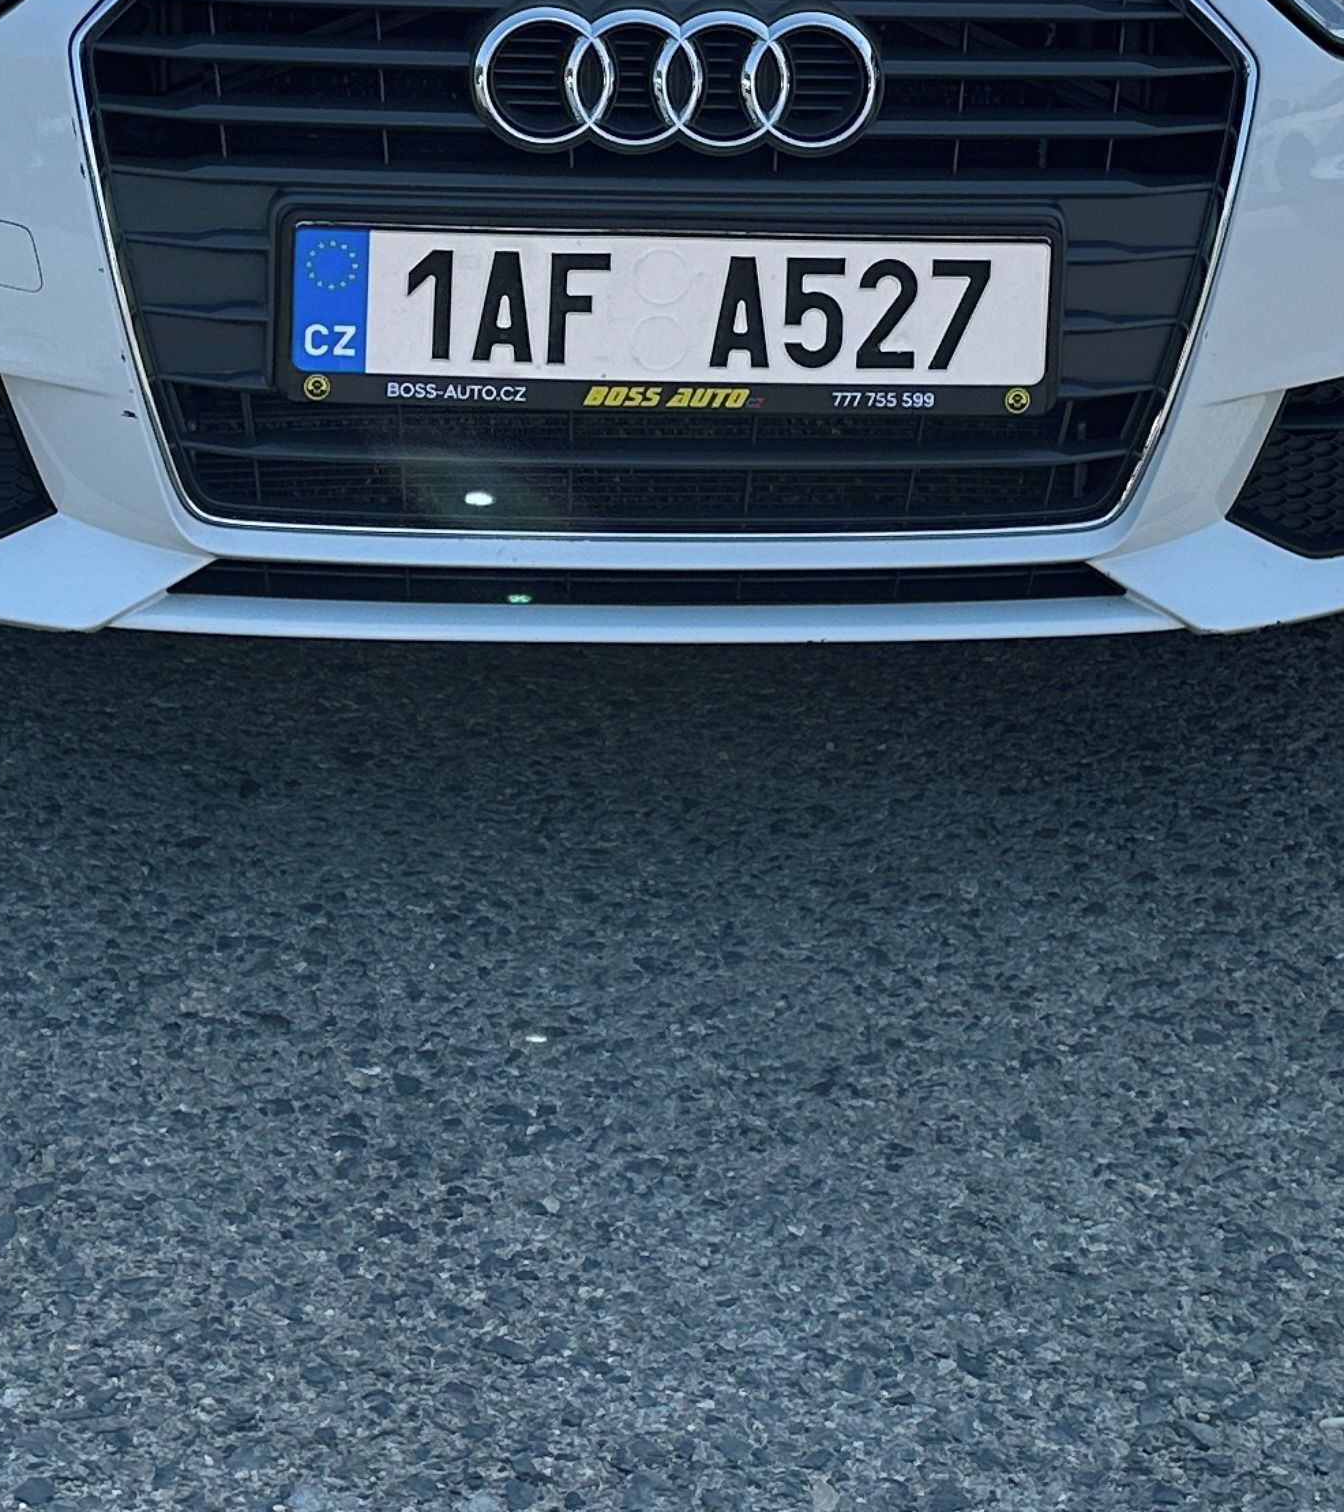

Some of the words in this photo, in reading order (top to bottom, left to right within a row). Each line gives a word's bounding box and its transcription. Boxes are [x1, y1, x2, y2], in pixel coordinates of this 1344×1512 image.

[406, 249, 612, 365] 1AF
[709, 255, 992, 370] A527
[303, 323, 357, 357] CZ
[386, 382, 527, 402] BOSS-AUTO.CZ
[582, 385, 663, 407] BOSS
[665, 388, 750, 408] AUTO
[832, 392, 861, 407] 777
[865, 392, 897, 407] 755
[901, 392, 935, 408] 599
